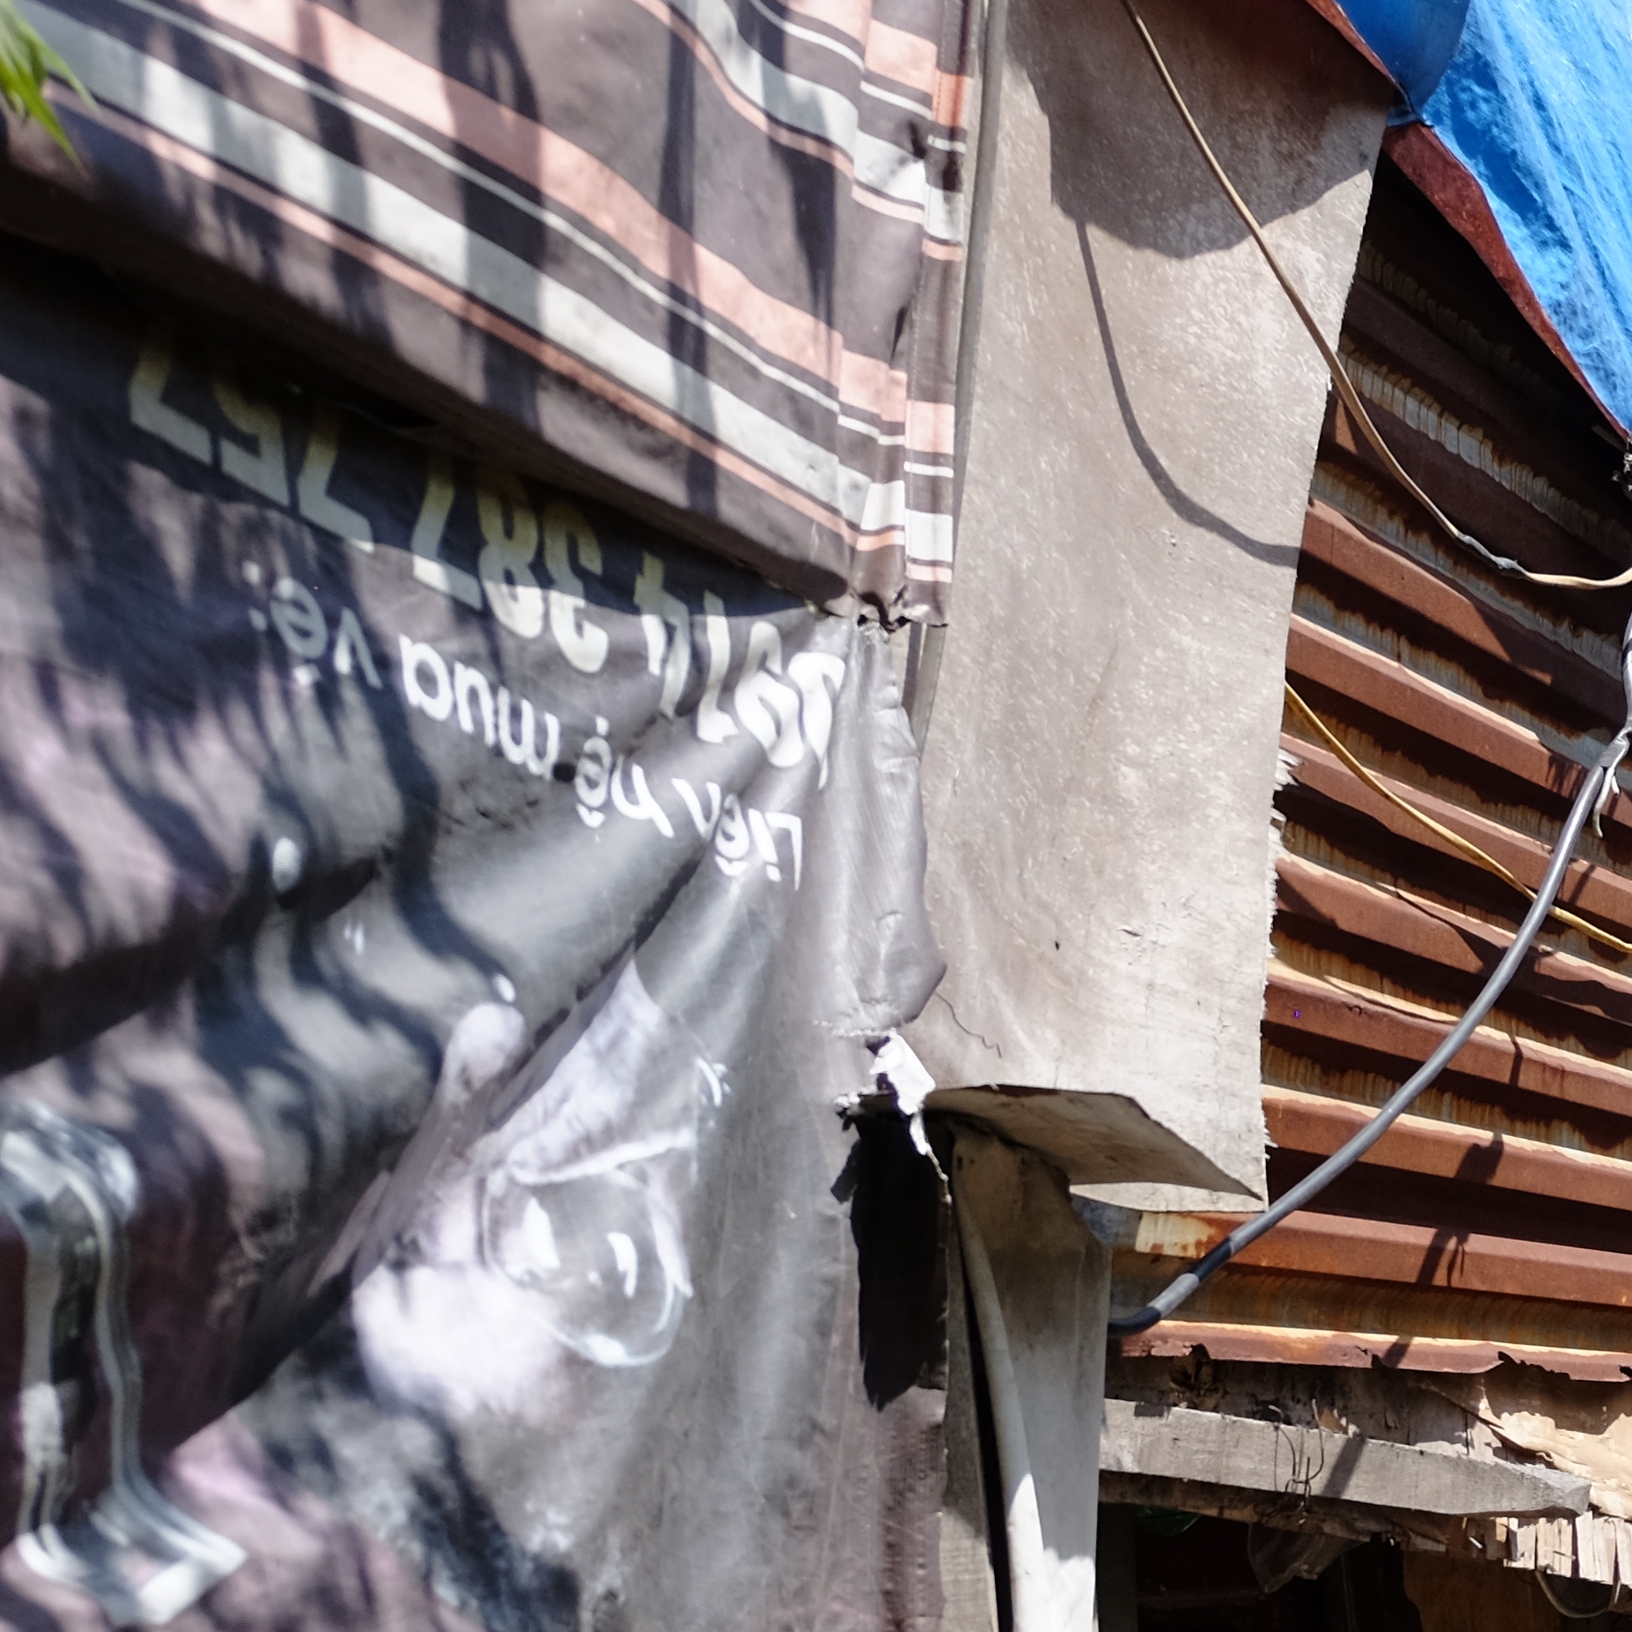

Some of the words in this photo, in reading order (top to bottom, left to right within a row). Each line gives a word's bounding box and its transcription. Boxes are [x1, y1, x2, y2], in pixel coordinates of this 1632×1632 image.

[128, 337, 374, 553] 757
[411, 451, 609, 673] 387
[400, 633, 561, 778] mua
[573, 714, 674, 838] hệ
[673, 776, 802, 891] Liên
